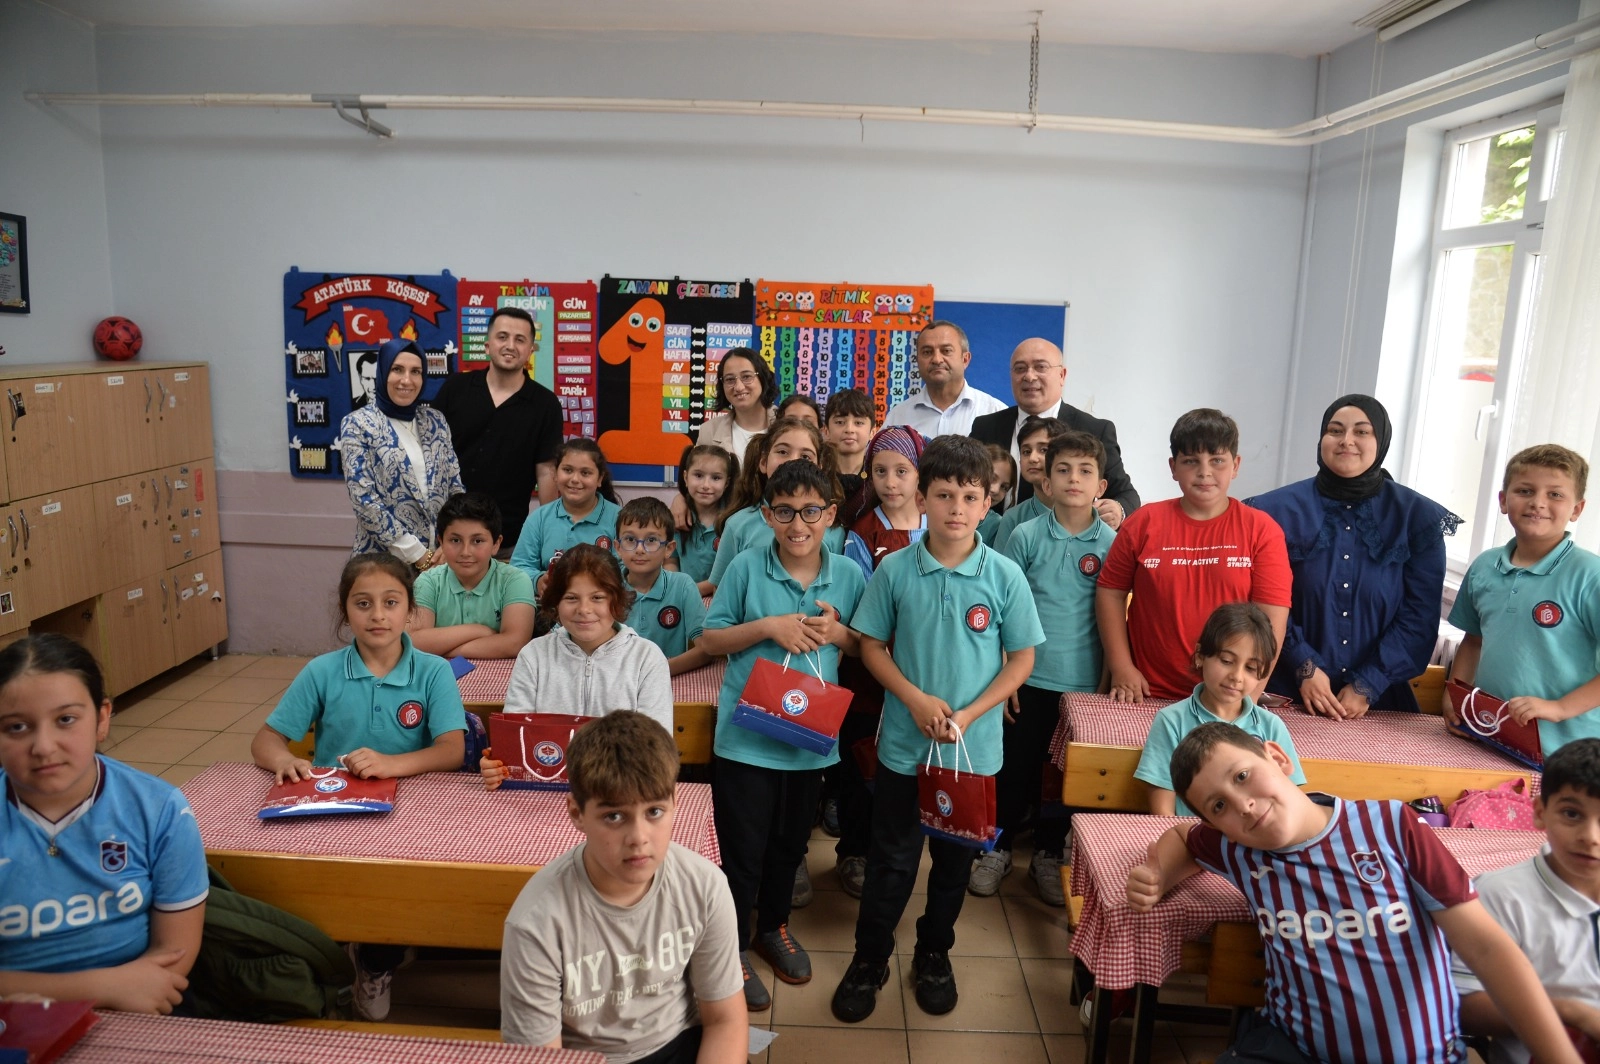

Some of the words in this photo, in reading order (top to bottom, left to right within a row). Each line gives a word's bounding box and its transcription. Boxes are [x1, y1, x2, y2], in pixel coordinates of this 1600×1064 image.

[313, 277, 372, 304] ATATÜRK
[386, 280, 430, 306] KÖŞESİ
[500, 284, 549, 296] TAKVİM
[617, 280, 669, 295] ZAMAN
[676, 281, 741, 299] ÇİZELGESİ
[820, 286, 870, 304] RİTMİK
[469, 295, 484, 305] AY
[504, 297, 546, 310] BUGÜN
[563, 297, 586, 309] GÜN
[814, 309, 872, 324] SAYILAR
[666, 327, 689, 335] SAAT
[707, 325, 720, 333] 60
[721, 324, 752, 334] DAKİKA
[765, 333, 771, 341] 2
[785, 334, 791, 342] 3
[859, 337, 864, 345] 7
[896, 337, 902, 345] 9
[667, 338, 687, 348] GÜN
[709, 337, 722, 347] 24
[726, 339, 748, 347] SAAT
[664, 351, 690, 359] HAFTA
[712, 350, 718, 358] 7
[784, 350, 790, 358] 6
[820, 353, 828, 361] 10
[841, 354, 849, 362] 12
[857, 354, 865, 362] 14
[877, 354, 885, 362] 16
[895, 354, 903, 362] 18
[671, 363, 684, 371] AY
[784, 367, 790, 375] 9
[801, 367, 808, 375] 12
[819, 370, 827, 378] 15
[910, 371, 920, 379] 30
[670, 375, 682, 383] AY
[560, 385, 587, 396] TARİH
[783, 384, 790, 392] 12
[801, 383, 808, 391] 16
[817, 386, 827, 394] 20
[670, 387, 683, 396] YIL
[892, 388, 903, 396] 36
[670, 399, 683, 408] YIL
[669, 411, 682, 419] YIL
[669, 422, 682, 431] YIL
[1192, 557, 1219, 566] ACTIVE
[1257, 901, 1412, 948] papara
[563, 949, 605, 999] NY
[658, 926, 695, 972] 86
